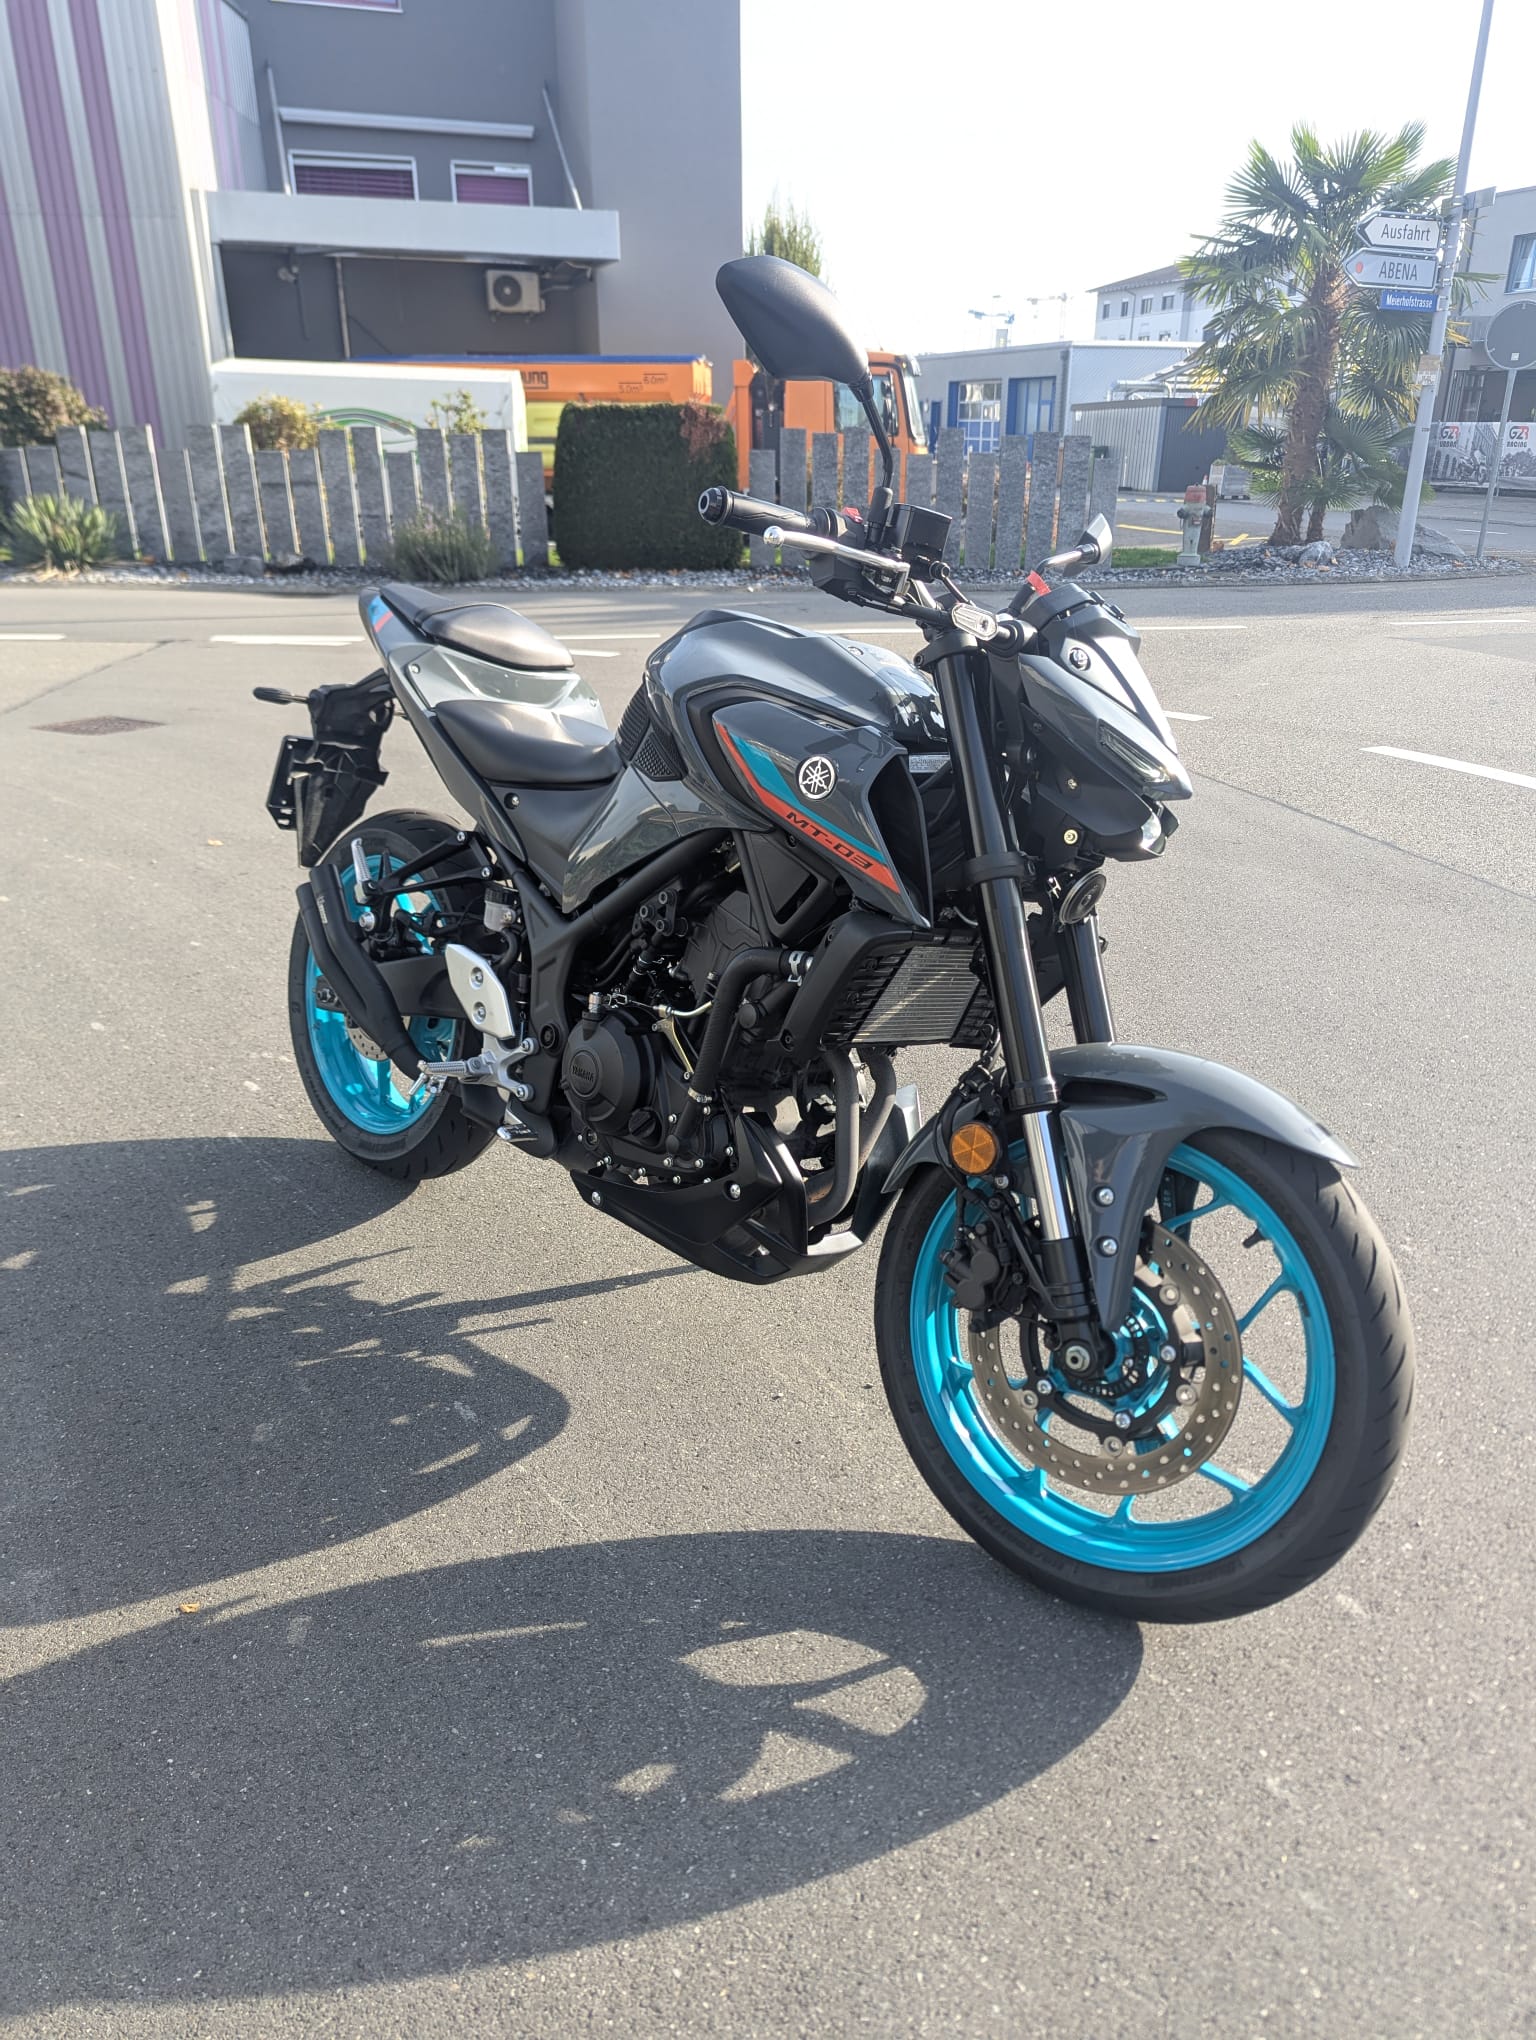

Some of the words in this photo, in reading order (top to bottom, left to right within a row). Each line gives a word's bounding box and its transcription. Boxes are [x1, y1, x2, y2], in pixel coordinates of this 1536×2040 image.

[1380, 223, 1431, 241] Ausfahrt
[1379, 261, 1418, 281] ABENA
[1386, 294, 1433, 309] Meierhofstrasse
[786, 811, 874, 870] MT-03
[571, 1064, 595, 1083] YAMAHA
